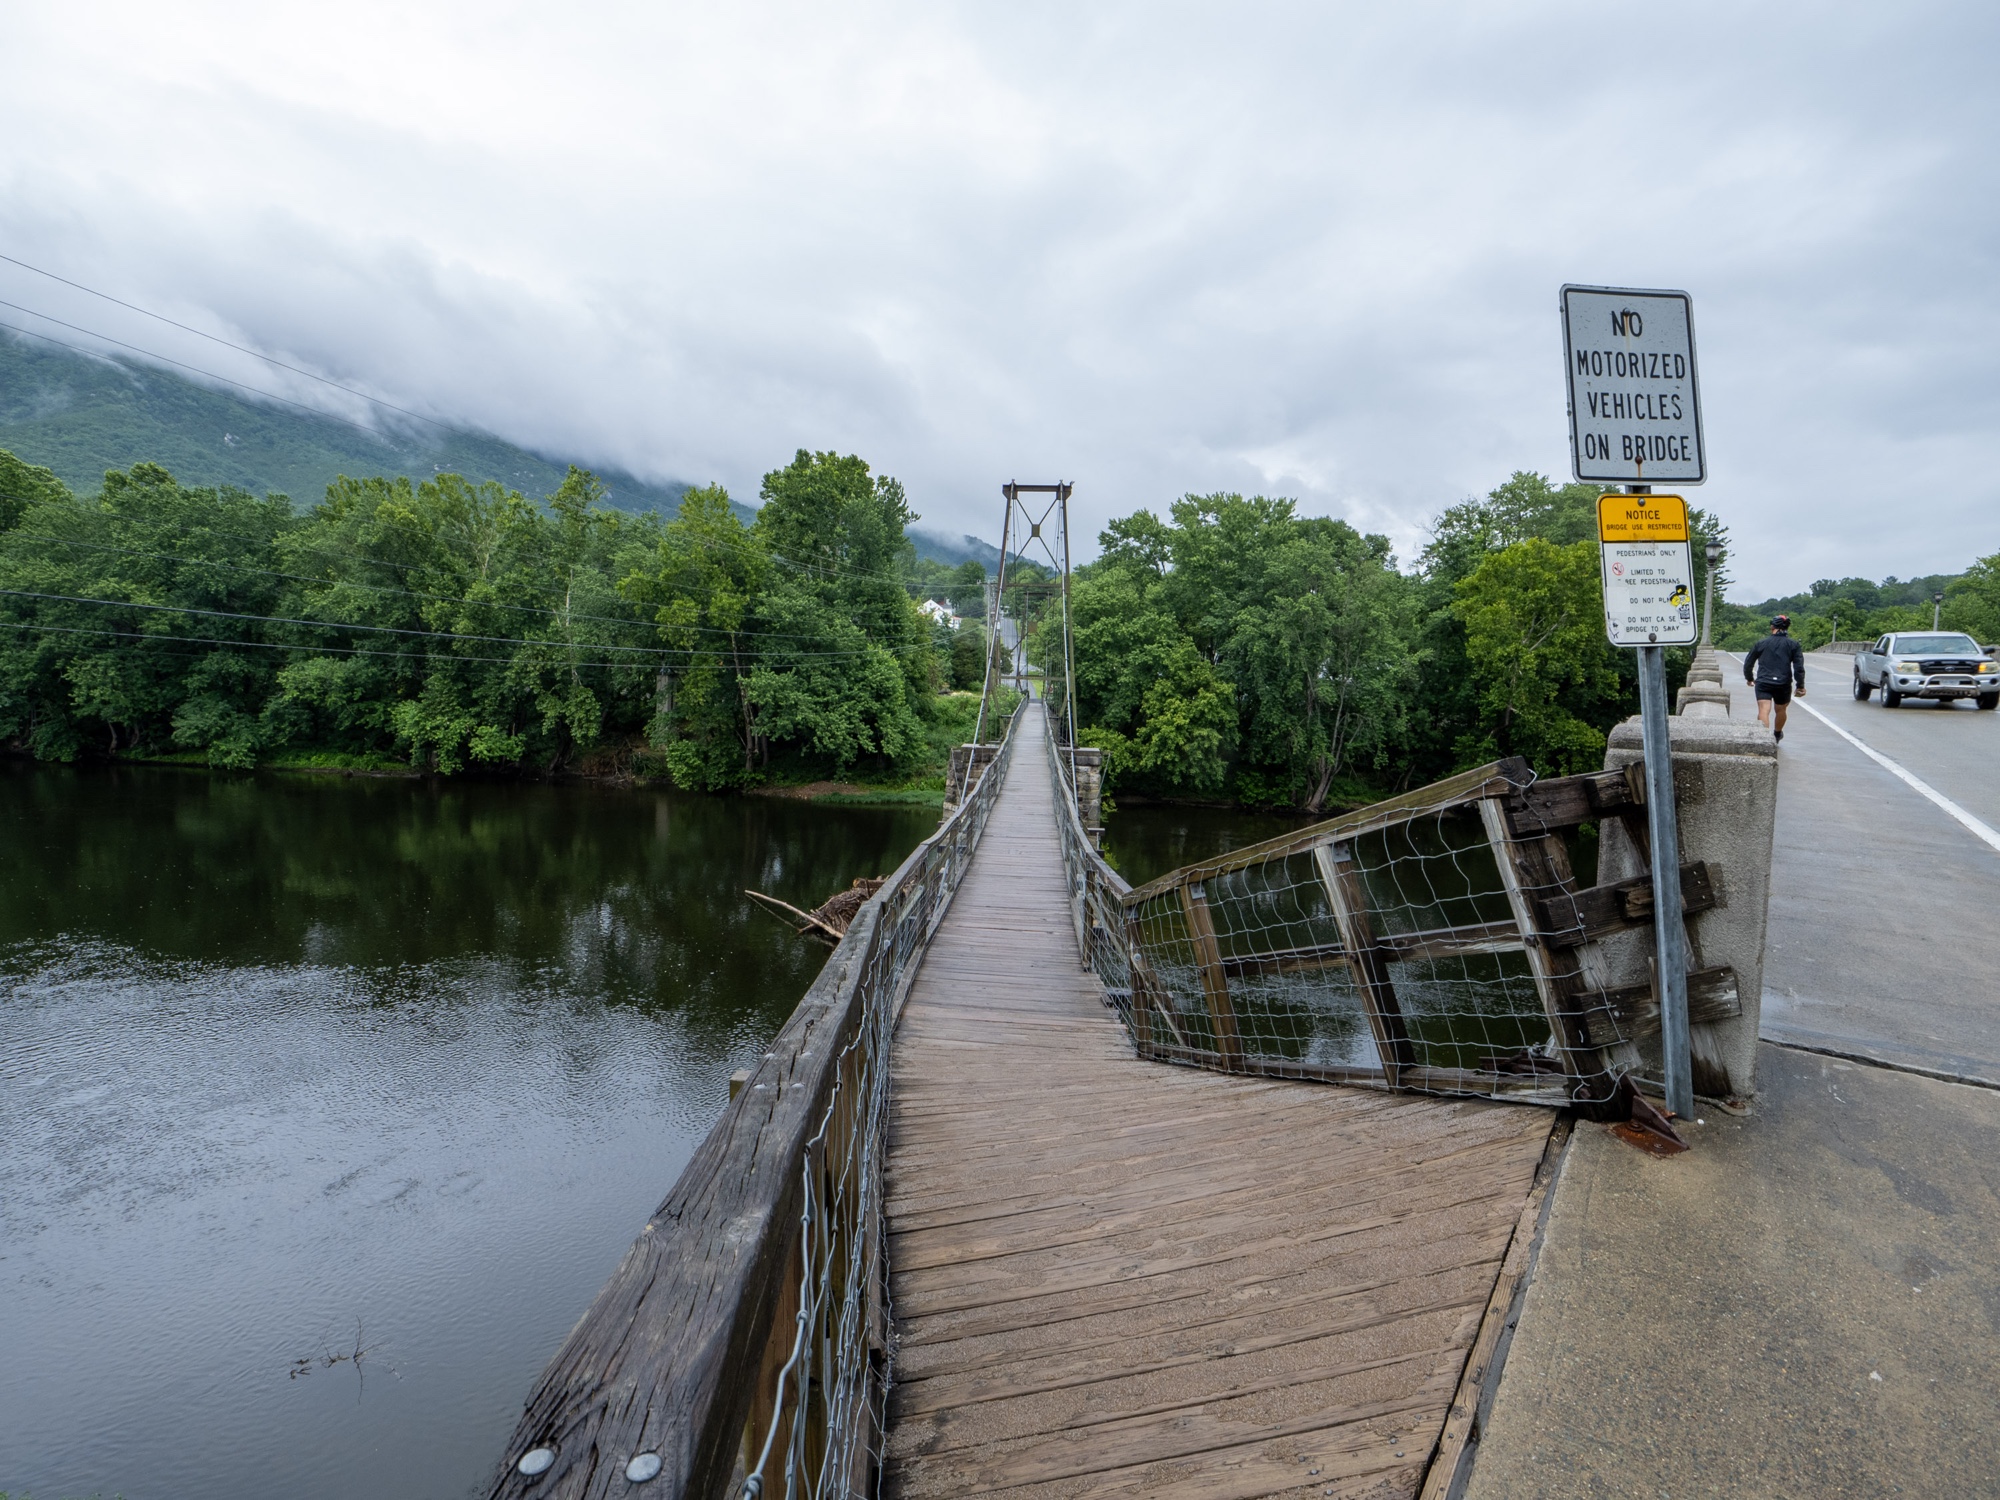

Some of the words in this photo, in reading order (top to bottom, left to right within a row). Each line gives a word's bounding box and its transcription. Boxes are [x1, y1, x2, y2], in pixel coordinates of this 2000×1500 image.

[1611, 310, 1643, 337] NO
[1576, 350, 1685, 379] MOTORIZED
[1587, 392, 1682, 420] VEHICLES
[1585, 433, 1610, 460] ON
[1622, 435, 1691, 461] BRIDGE
[1626, 510, 1660, 520] NOTICE
